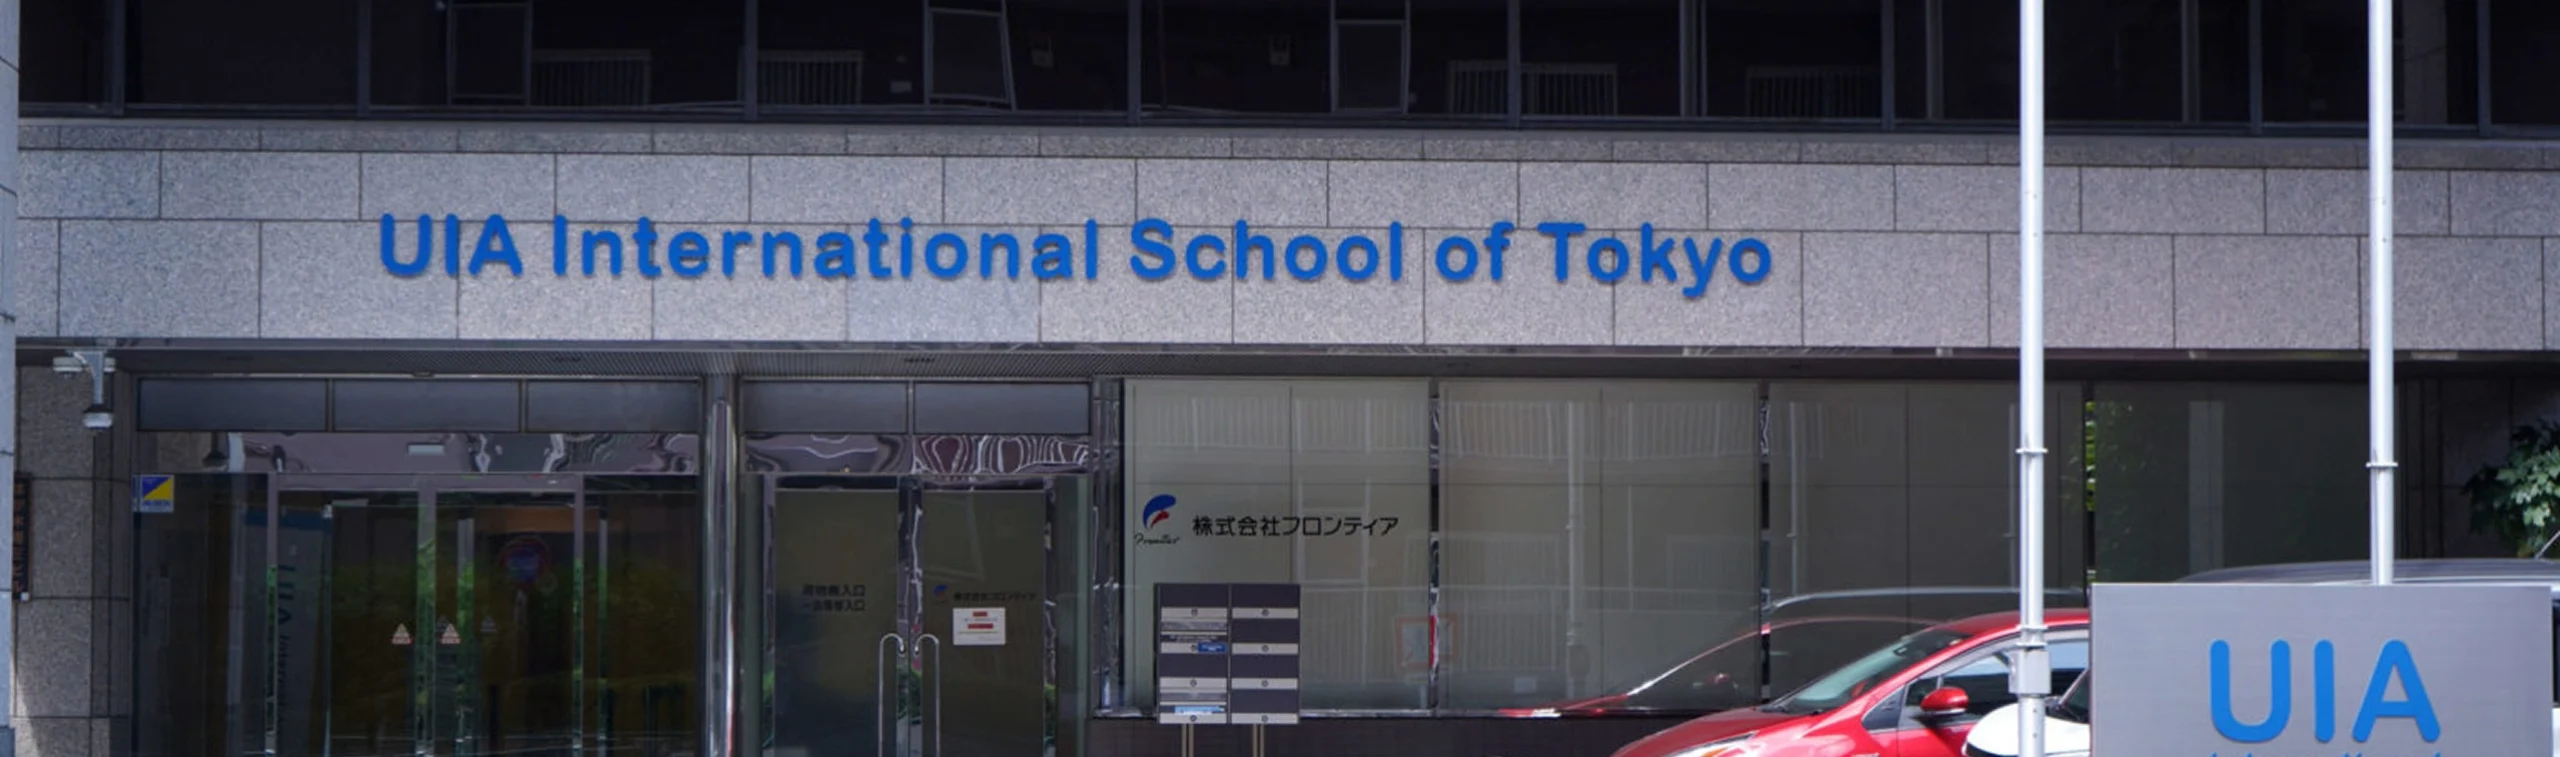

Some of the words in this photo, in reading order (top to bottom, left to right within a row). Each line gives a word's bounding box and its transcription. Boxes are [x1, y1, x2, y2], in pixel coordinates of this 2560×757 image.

[379, 212, 524, 277] UIA
[552, 213, 1099, 281] International
[1129, 218, 1403, 283] School
[1435, 220, 1515, 284] of
[1537, 221, 1773, 299] Tokyo
[1192, 515, 1399, 538] 株式会社フロンティア
[2209, 638, 2442, 744] UIA
